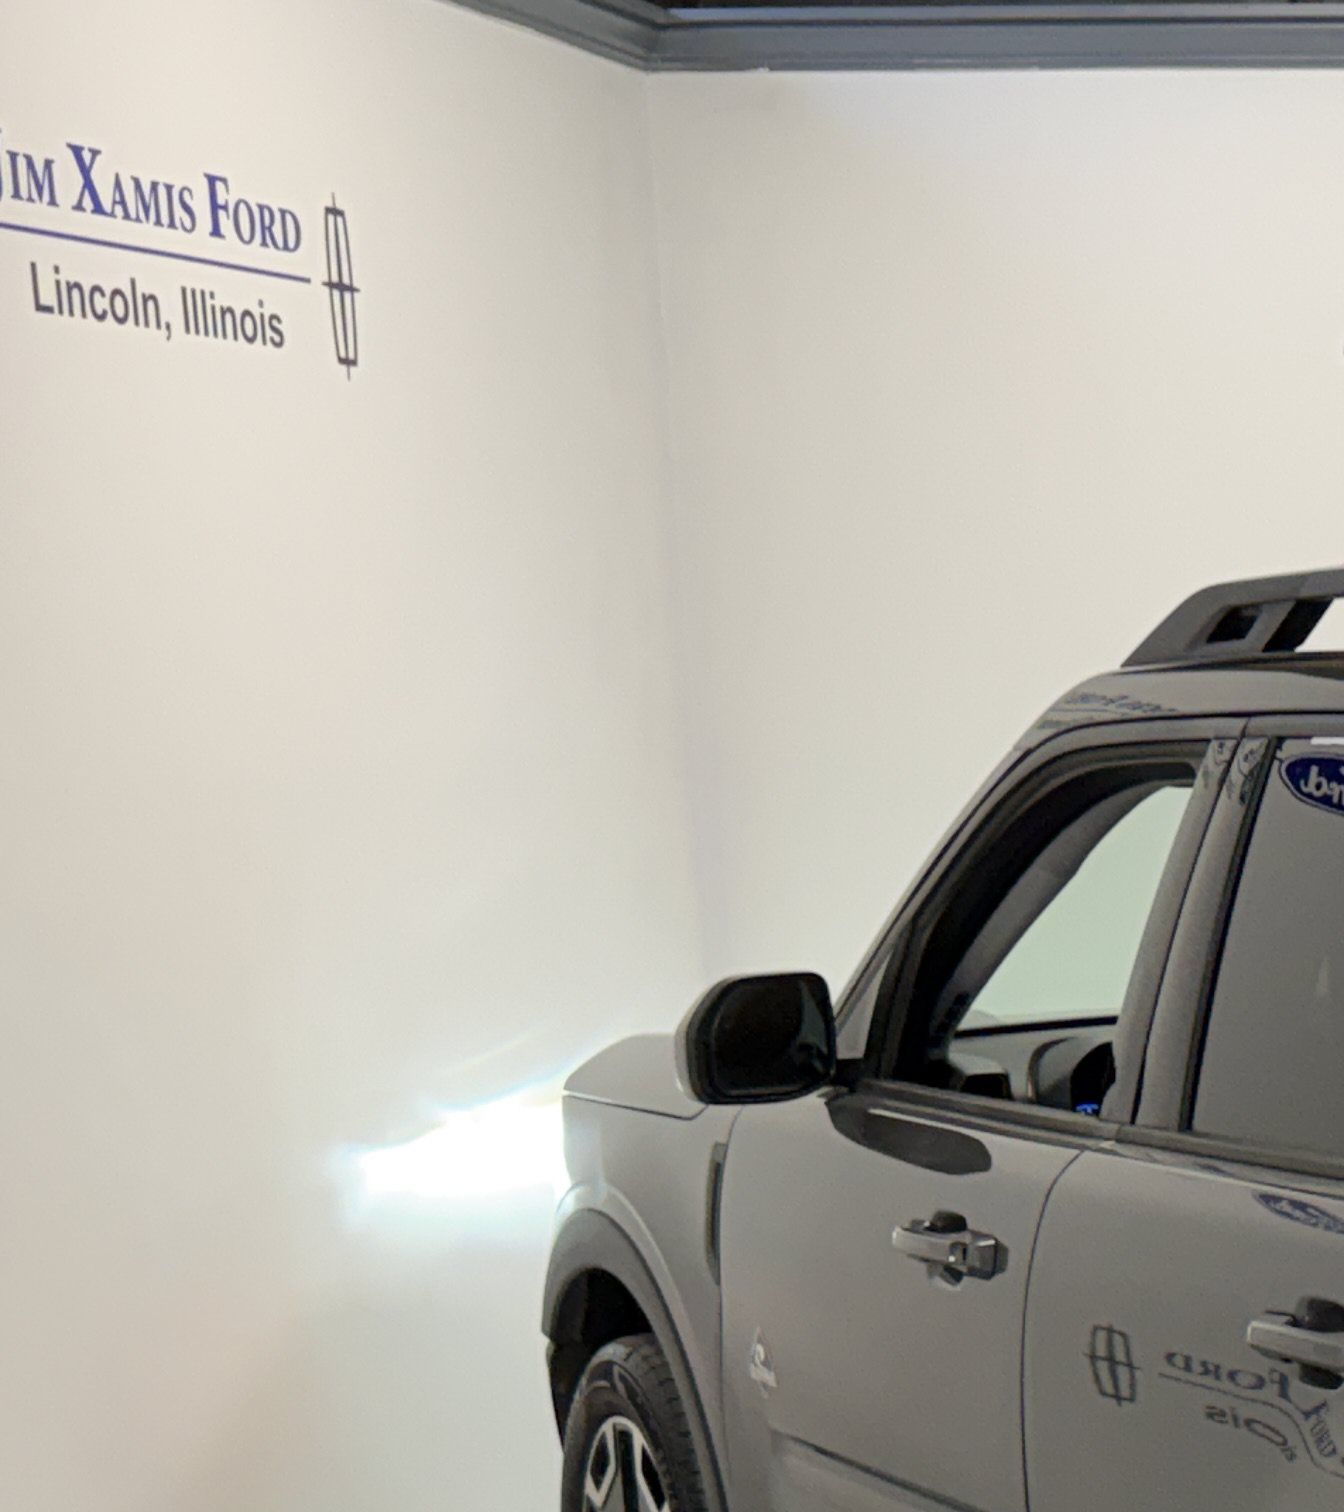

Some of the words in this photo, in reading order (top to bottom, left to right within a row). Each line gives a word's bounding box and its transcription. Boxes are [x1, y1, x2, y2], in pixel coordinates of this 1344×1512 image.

[0, 127, 59, 207] IM
[66, 142, 197, 233] XAMIS
[203, 172, 302, 253] FORD
[30, 262, 172, 341] Lincoln,
[180, 286, 285, 349] Illinois
